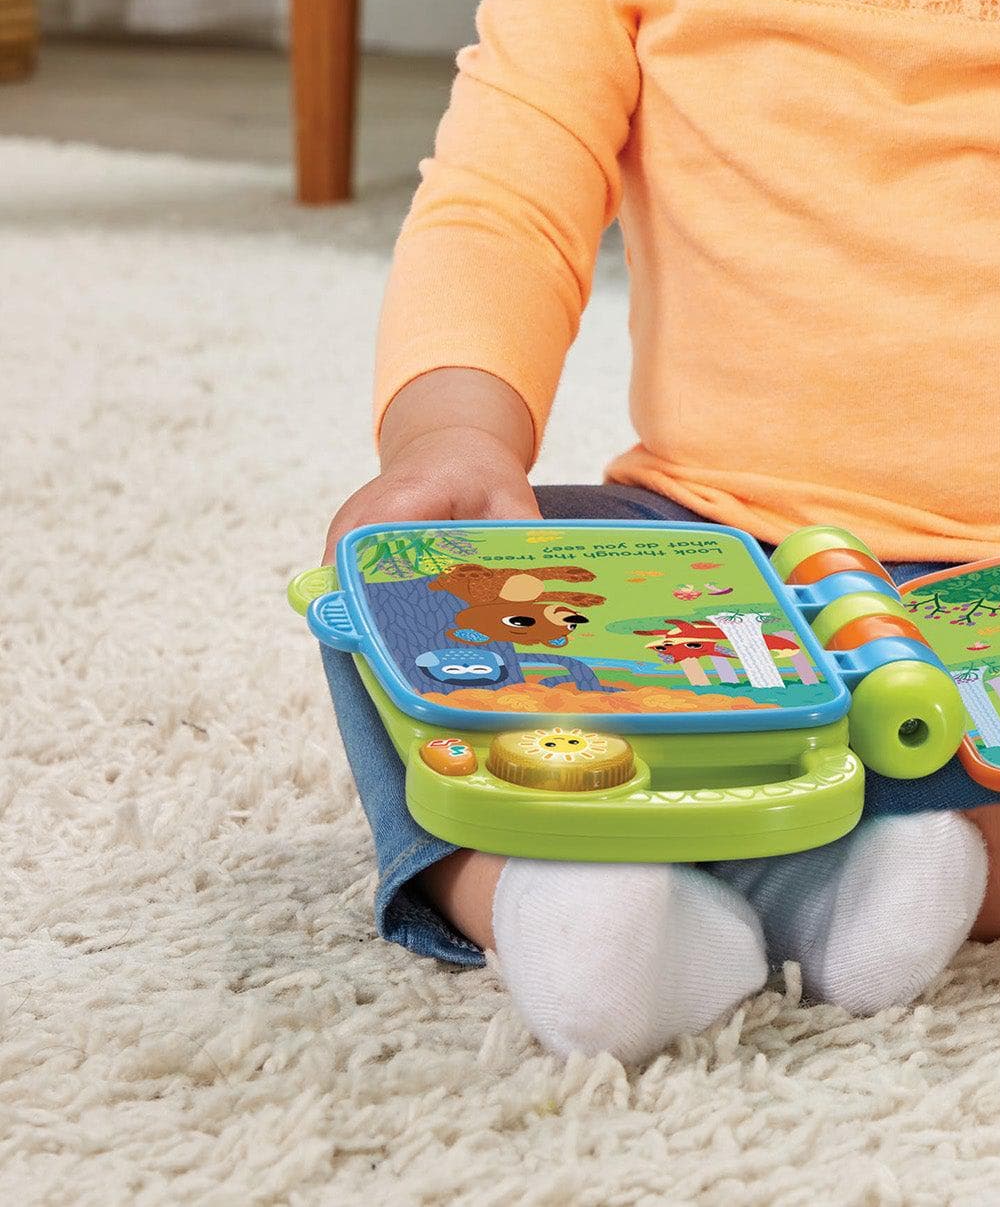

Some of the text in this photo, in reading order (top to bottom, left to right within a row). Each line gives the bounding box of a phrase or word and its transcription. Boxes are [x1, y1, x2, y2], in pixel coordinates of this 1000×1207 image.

[542, 544, 586, 553] see?
[593, 541, 628, 550] you
[667, 540, 719, 548] what
[583, 549, 667, 560] through
[673, 547, 723, 556] Look
